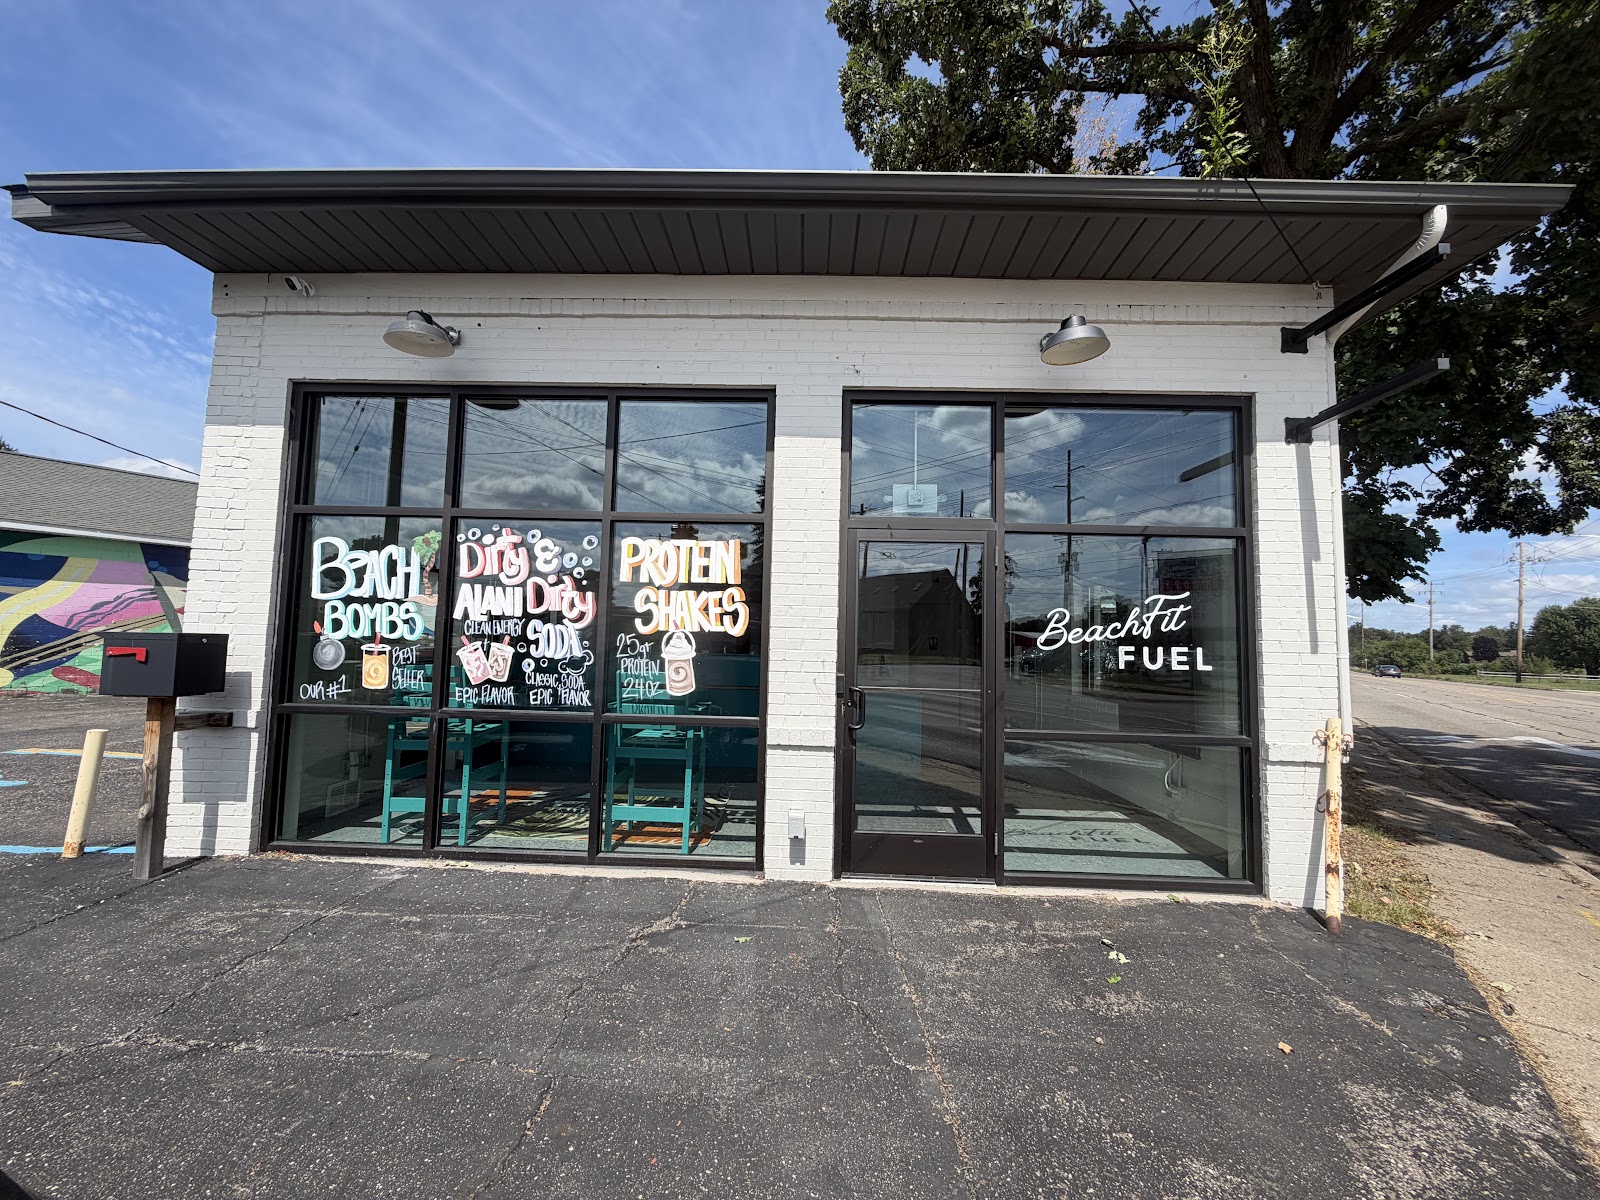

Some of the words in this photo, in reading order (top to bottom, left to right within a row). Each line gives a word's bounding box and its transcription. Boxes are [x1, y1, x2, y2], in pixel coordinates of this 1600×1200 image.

[459, 527, 530, 586] Dirty
[534, 538, 562, 574] &
[619, 536, 741, 588] PROTEIN
[452, 583, 523, 621] ALANI
[527, 575, 597, 629] Dirty
[634, 585, 750, 638] SHAKES
[323, 600, 425, 641] BOMBS
[464, 619, 492, 636] CLEAN
[493, 618, 525, 637] ENERGY
[527, 618, 583, 660] SODA
[392, 644, 420, 667] BEST
[620, 657, 660, 678] PROTEIN
[1118, 645, 1213, 671] FUEL
[299, 681, 325, 700] OUR
[326, 674, 352, 700] #1
[392, 667, 425, 690] SELLER
[525, 671, 558, 688] CLASSIC
[560, 673, 586, 690] SODA
[455, 686, 479, 704] EPIC
[481, 684, 515, 705] FLAVOR
[529, 688, 553, 704] EPIC
[561, 687, 592, 706] FLAVOR
